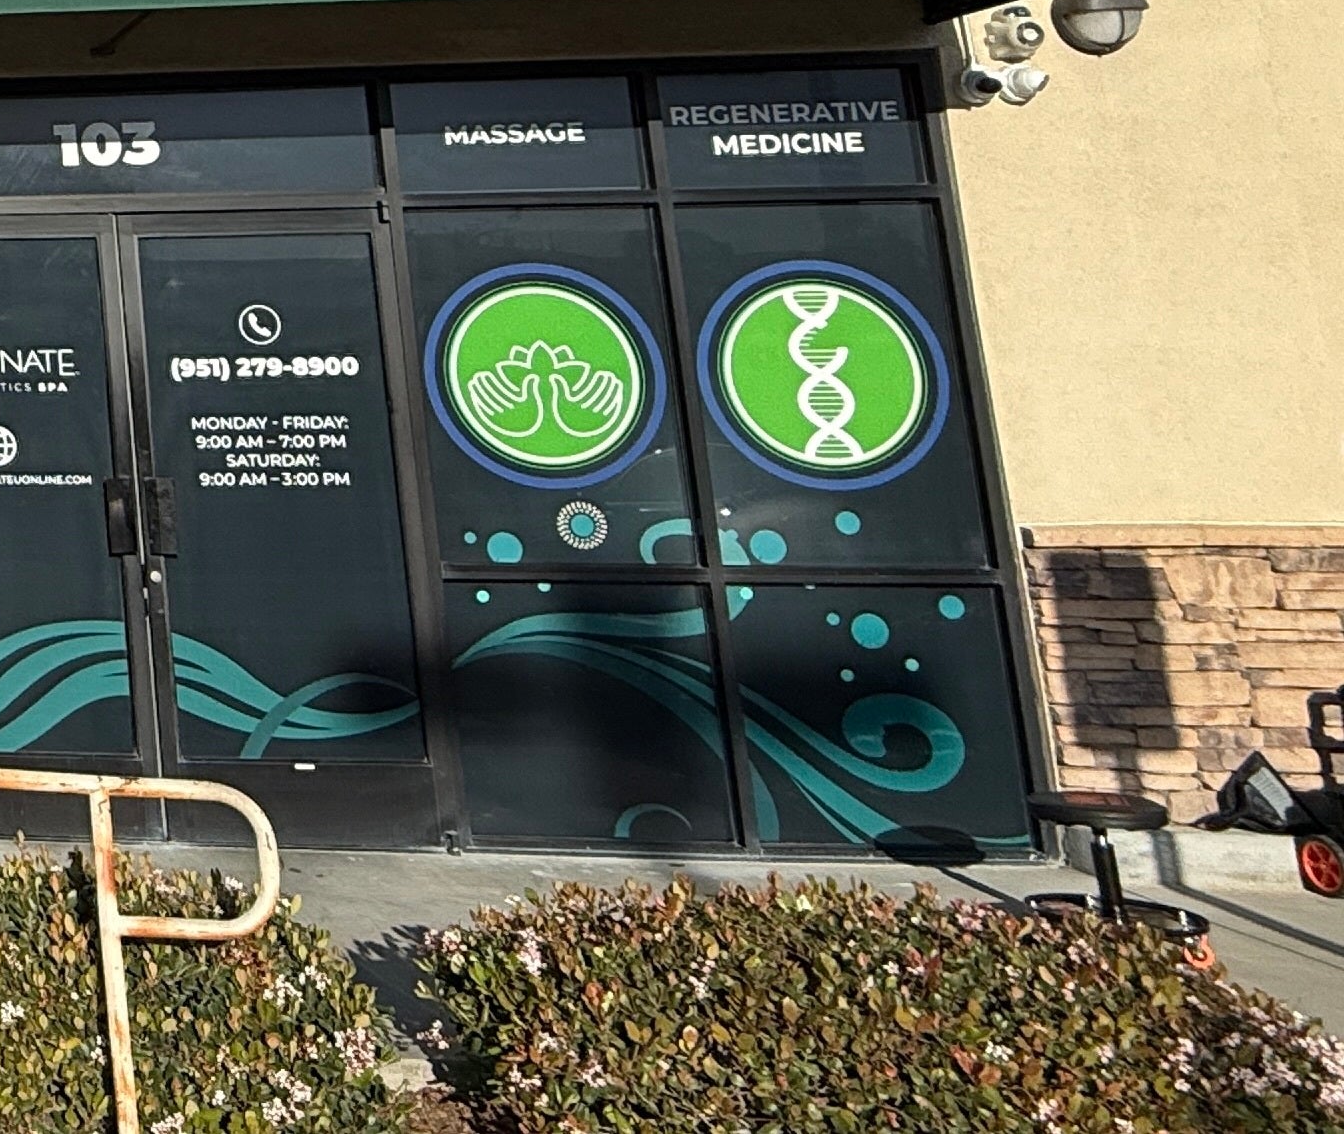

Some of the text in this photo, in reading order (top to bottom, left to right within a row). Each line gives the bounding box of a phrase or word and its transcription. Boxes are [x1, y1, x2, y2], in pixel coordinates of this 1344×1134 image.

[668, 100, 900, 127] REGENERATIVE
[53, 121, 161, 167] 103
[444, 122, 586, 146] MASSAGE
[711, 131, 866, 157] MEDICINE
[170, 356, 360, 382] (951) 279-8900
[36, 381, 69, 393] SPA
[191, 416, 268, 430] MONDAY
[282, 415, 350, 430] FRIDAY:
[195, 434, 232, 449] 9:00
[235, 435, 264, 449] AM
[278, 434, 316, 449] 7:00
[318, 434, 347, 448] PM
[225, 453, 321, 468] SATURDAY:
[198, 472, 236, 488] 9:00
[239, 472, 268, 486] AM
[322, 472, 351, 486] PM
